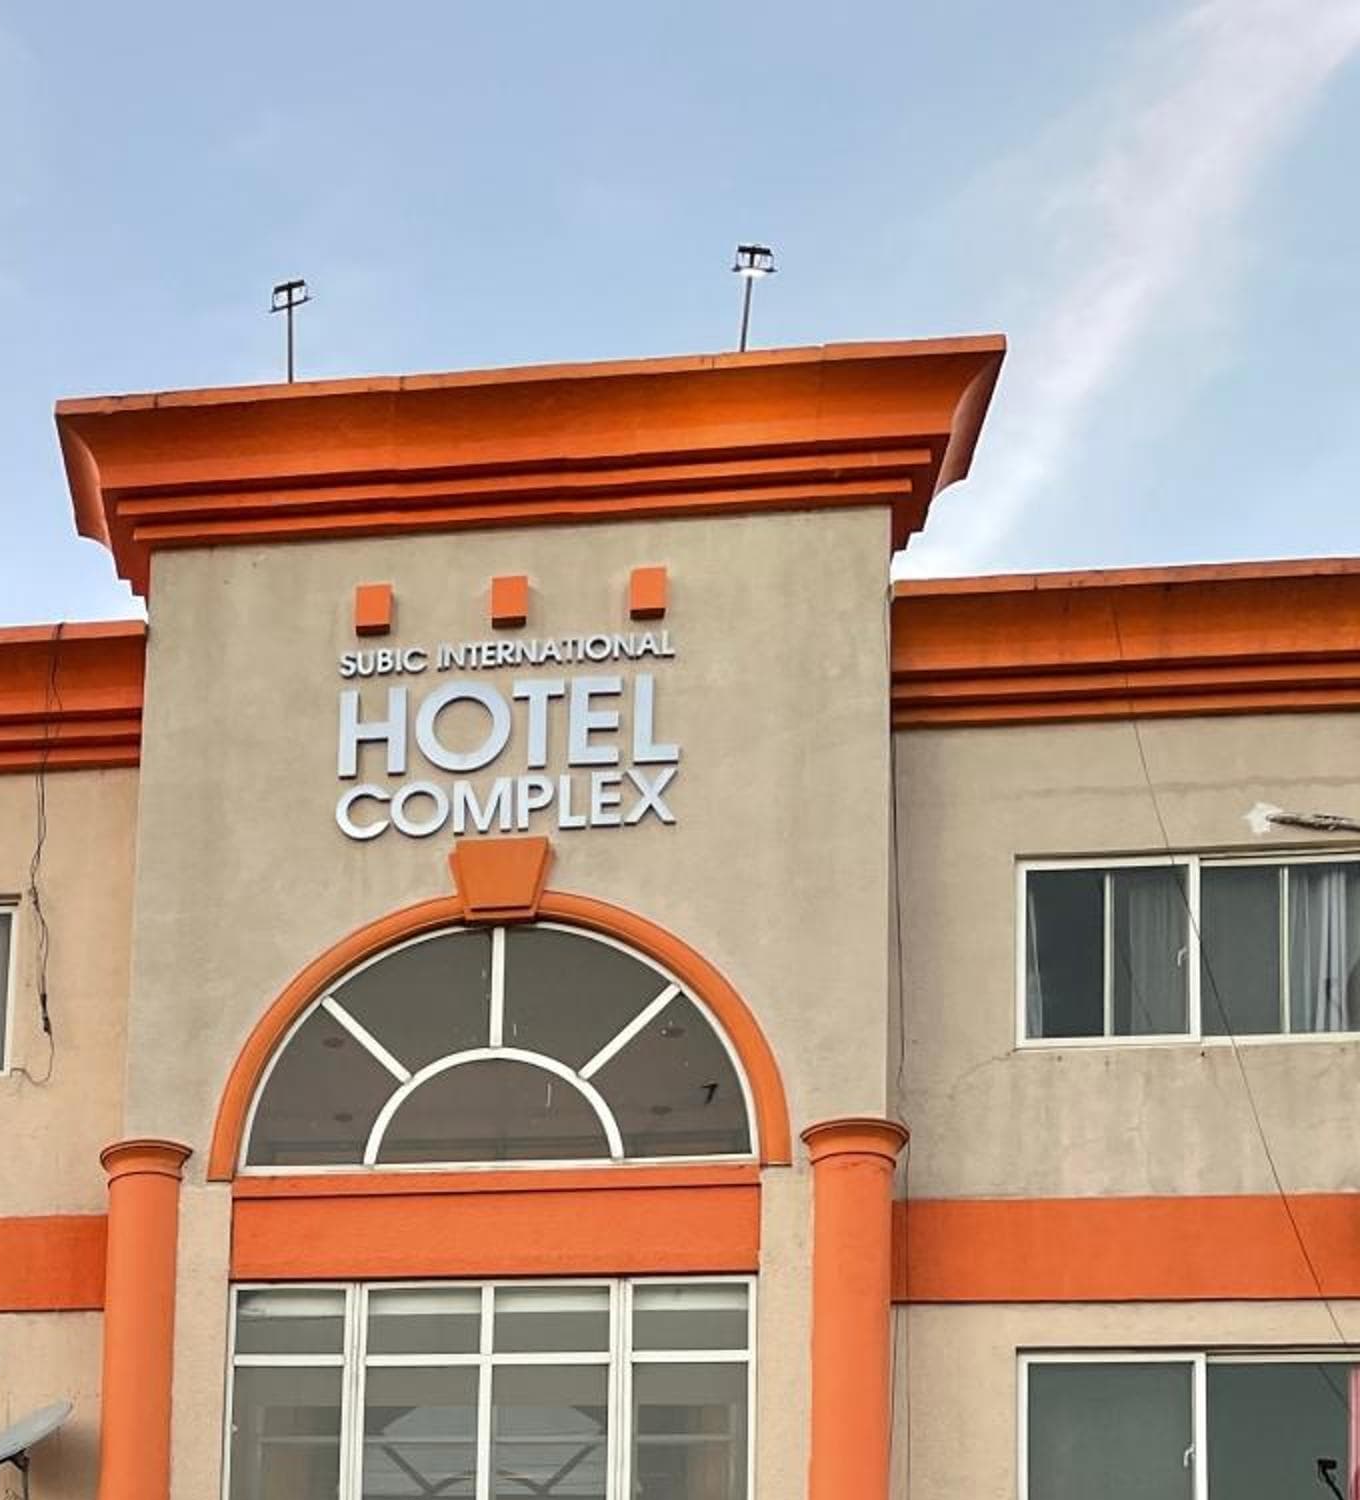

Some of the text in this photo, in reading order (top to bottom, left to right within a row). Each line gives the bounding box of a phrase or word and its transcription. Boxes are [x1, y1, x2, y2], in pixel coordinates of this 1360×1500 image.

[340, 630, 676, 678] SUBIC INTERNATIONAL
[339, 672, 681, 778] HOTEL
[336, 767, 678, 840] COMPLEX
